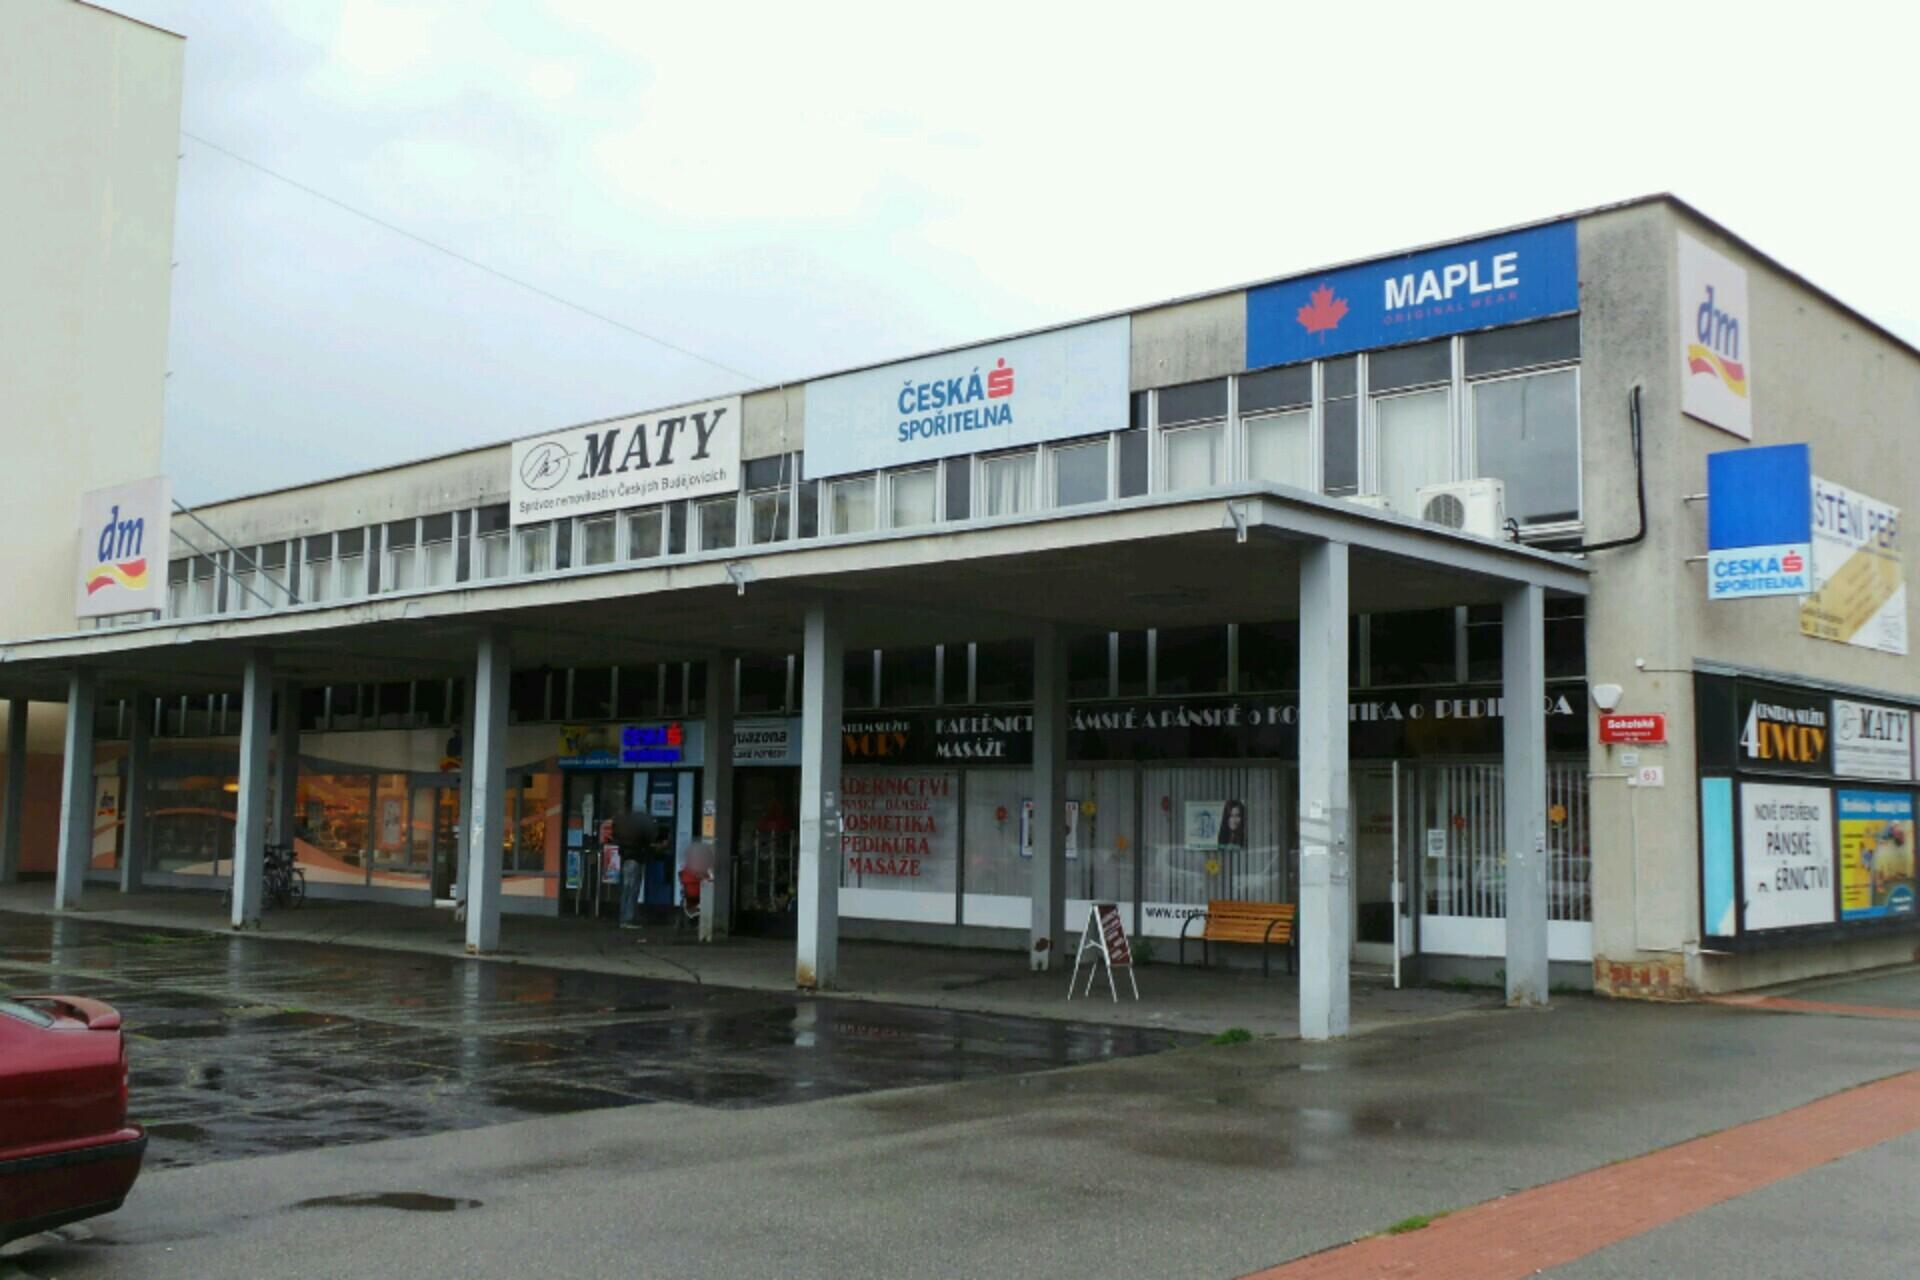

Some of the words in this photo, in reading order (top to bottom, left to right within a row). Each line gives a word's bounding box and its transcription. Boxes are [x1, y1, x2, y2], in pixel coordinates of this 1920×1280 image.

[1385, 251, 1520, 311] MAPLE
[1697, 284, 1739, 360] dm
[898, 366, 985, 415] ČESKÁ
[898, 402, 1013, 442] SPOŘITELNA
[577, 408, 728, 480] MATY
[98, 505, 144, 563] dm
[1714, 553, 1780, 577] ČESKÁ
[1715, 576, 1805, 593] SPOŘITELNA
[1067, 708, 1136, 730] ÁMSKÉ
[1140, 712, 1156, 728] A
[1161, 706, 1241, 727] PÁNSKÉ
[1739, 700, 1760, 758] 4
[1858, 708, 1907, 742] MATY
[844, 734, 908, 757] VORY
[935, 738, 1004, 757] MASÁŽE
[1759, 720, 1825, 762] DVORY
[843, 814, 937, 832] OSMETIKA
[1766, 824, 1811, 856] PÁNSKÉ
[848, 856, 921, 876] MASÁŽE
